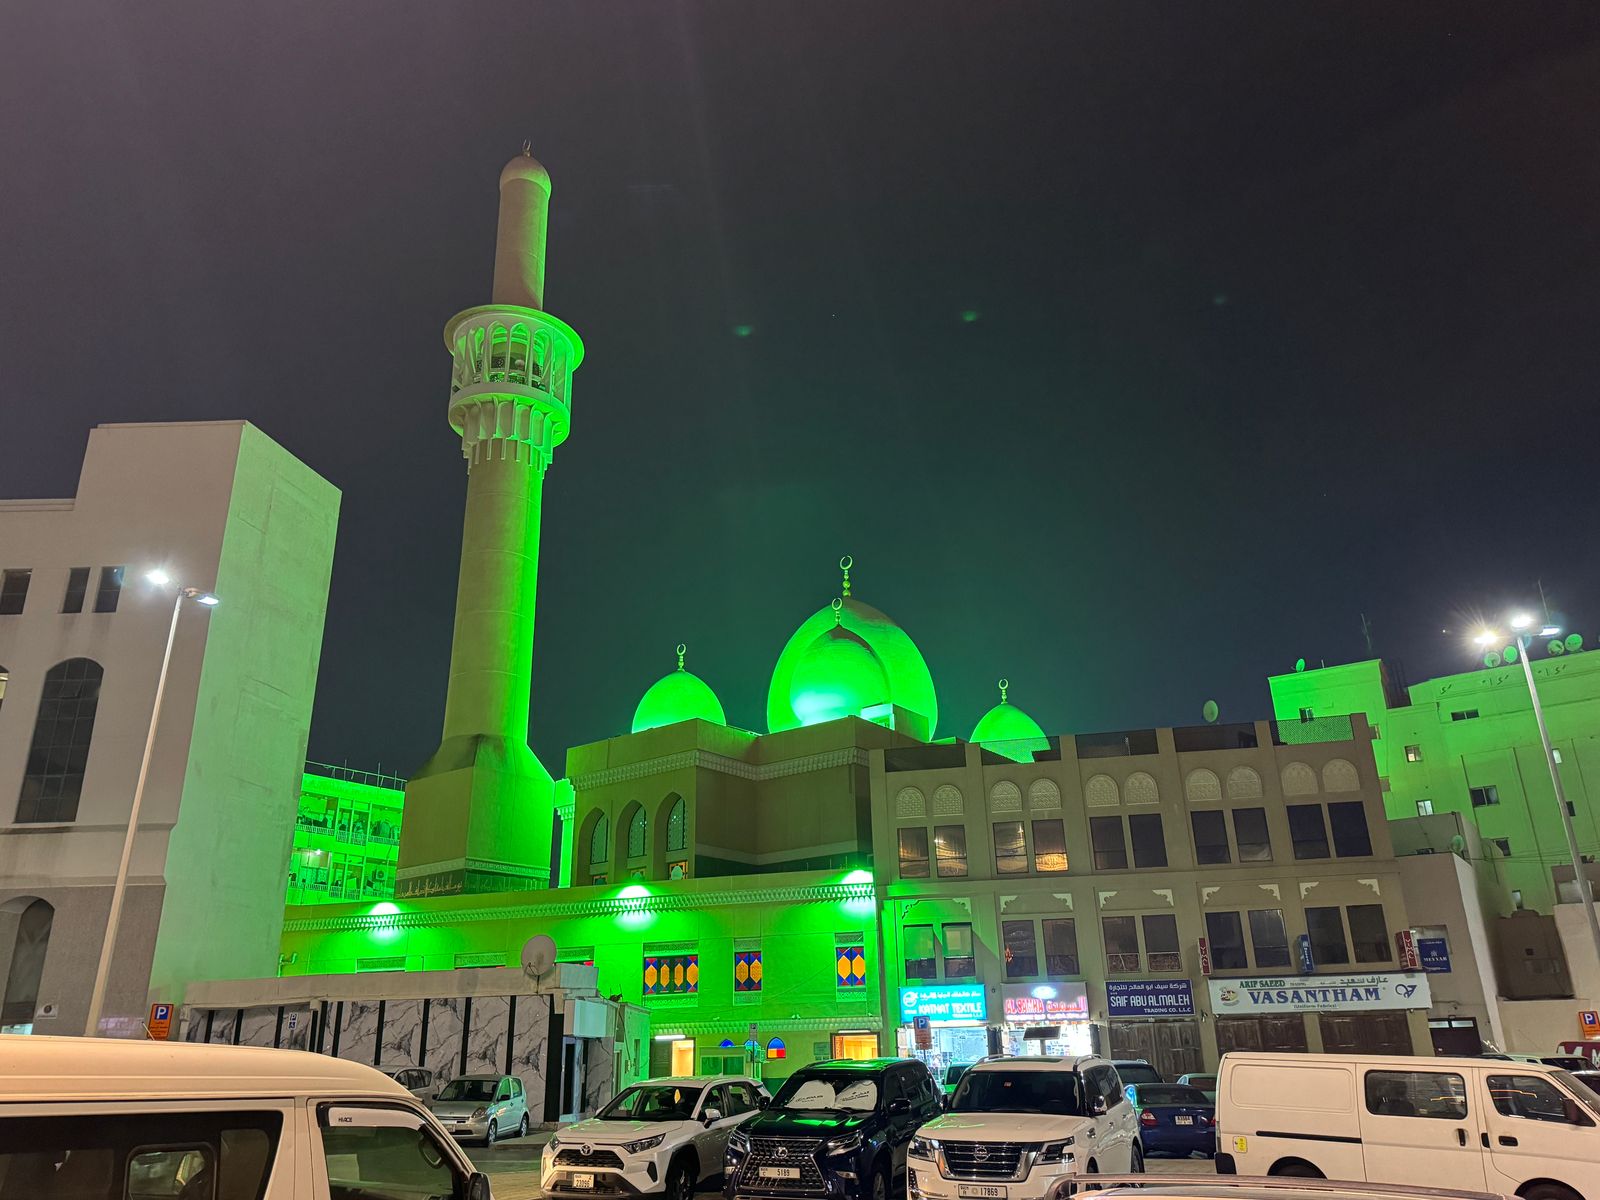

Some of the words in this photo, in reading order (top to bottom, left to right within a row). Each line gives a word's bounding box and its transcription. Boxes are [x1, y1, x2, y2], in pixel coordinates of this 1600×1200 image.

[1259, 980, 1286, 988] SAEED
[1110, 995, 1129, 1007] SAIF
[1130, 995, 1147, 1007] ABU
[1148, 994, 1190, 1007] ALMALEH
[1248, 987, 1382, 1005] VASANTHAM
[951, 1002, 983, 1013] TEXTILE
[1005, 998, 1017, 1014] AL
[156, 1006, 167, 1019] P
[1584, 1013, 1593, 1024] P
[918, 1018, 926, 1028] P
